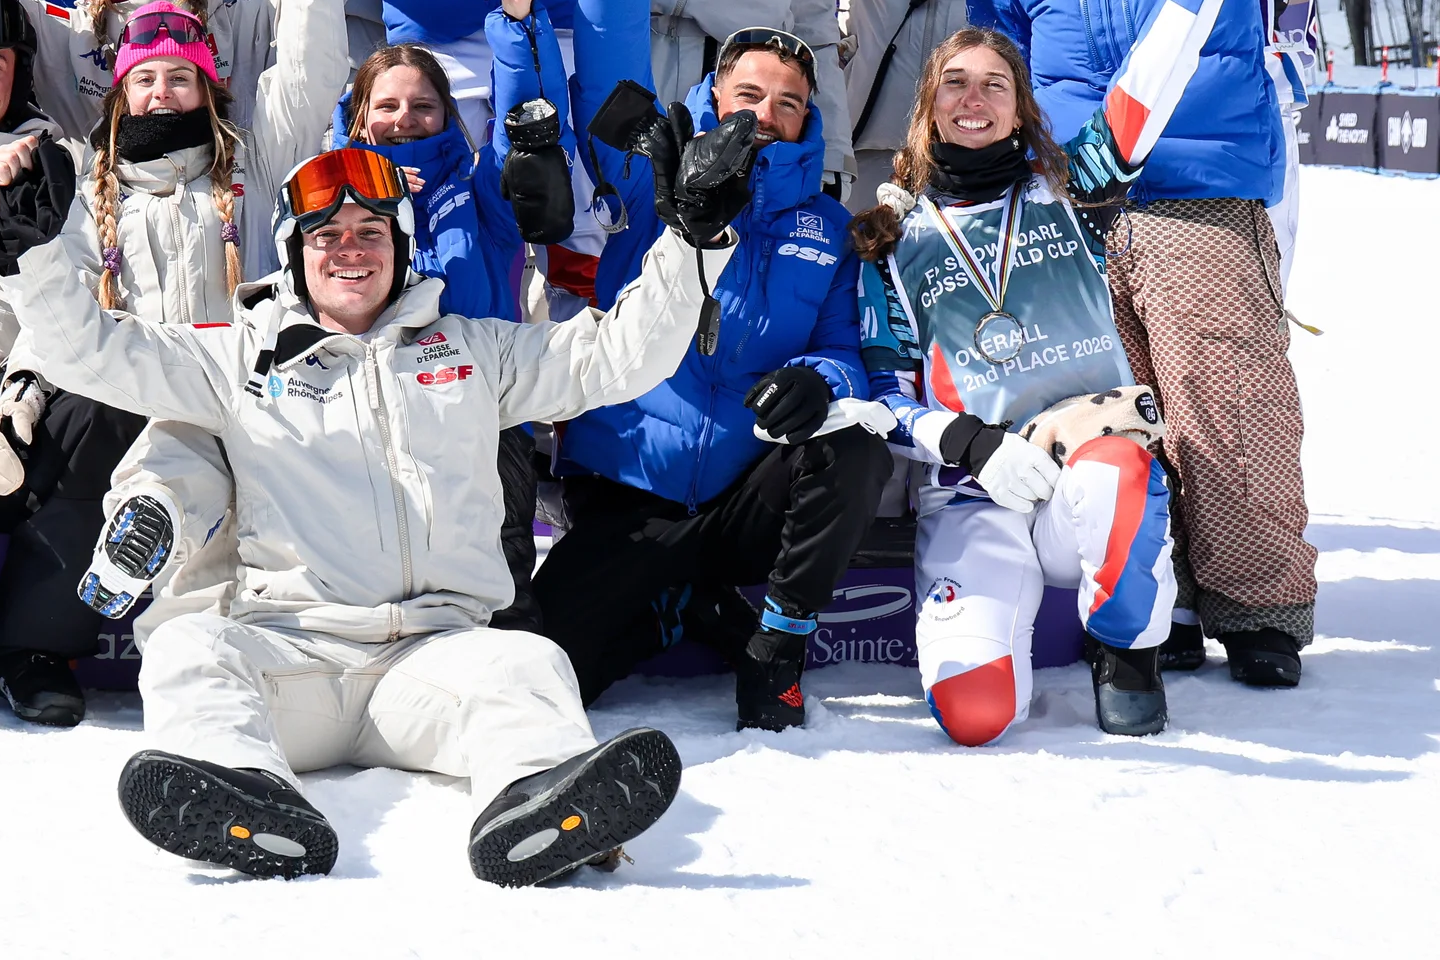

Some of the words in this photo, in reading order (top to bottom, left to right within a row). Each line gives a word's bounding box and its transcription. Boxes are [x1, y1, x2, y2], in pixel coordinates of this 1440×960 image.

[789, 231, 831, 245] D'EPARGNE
[796, 227, 824, 238] CAISSE
[1047, 240, 1079, 259] CUP
[422, 343, 452, 355] CAISSE
[955, 324, 1048, 367] OVERALL
[416, 348, 461, 364] D'EPARGNE
[963, 365, 1000, 393] 2nd
[1002, 346, 1071, 377] PLACE
[1074, 334, 1114, 360] 2026
[287, 387, 344, 405] Rhône-Alpes
[943, 576, 962, 589] France
[934, 606, 966, 622] Snowboard
